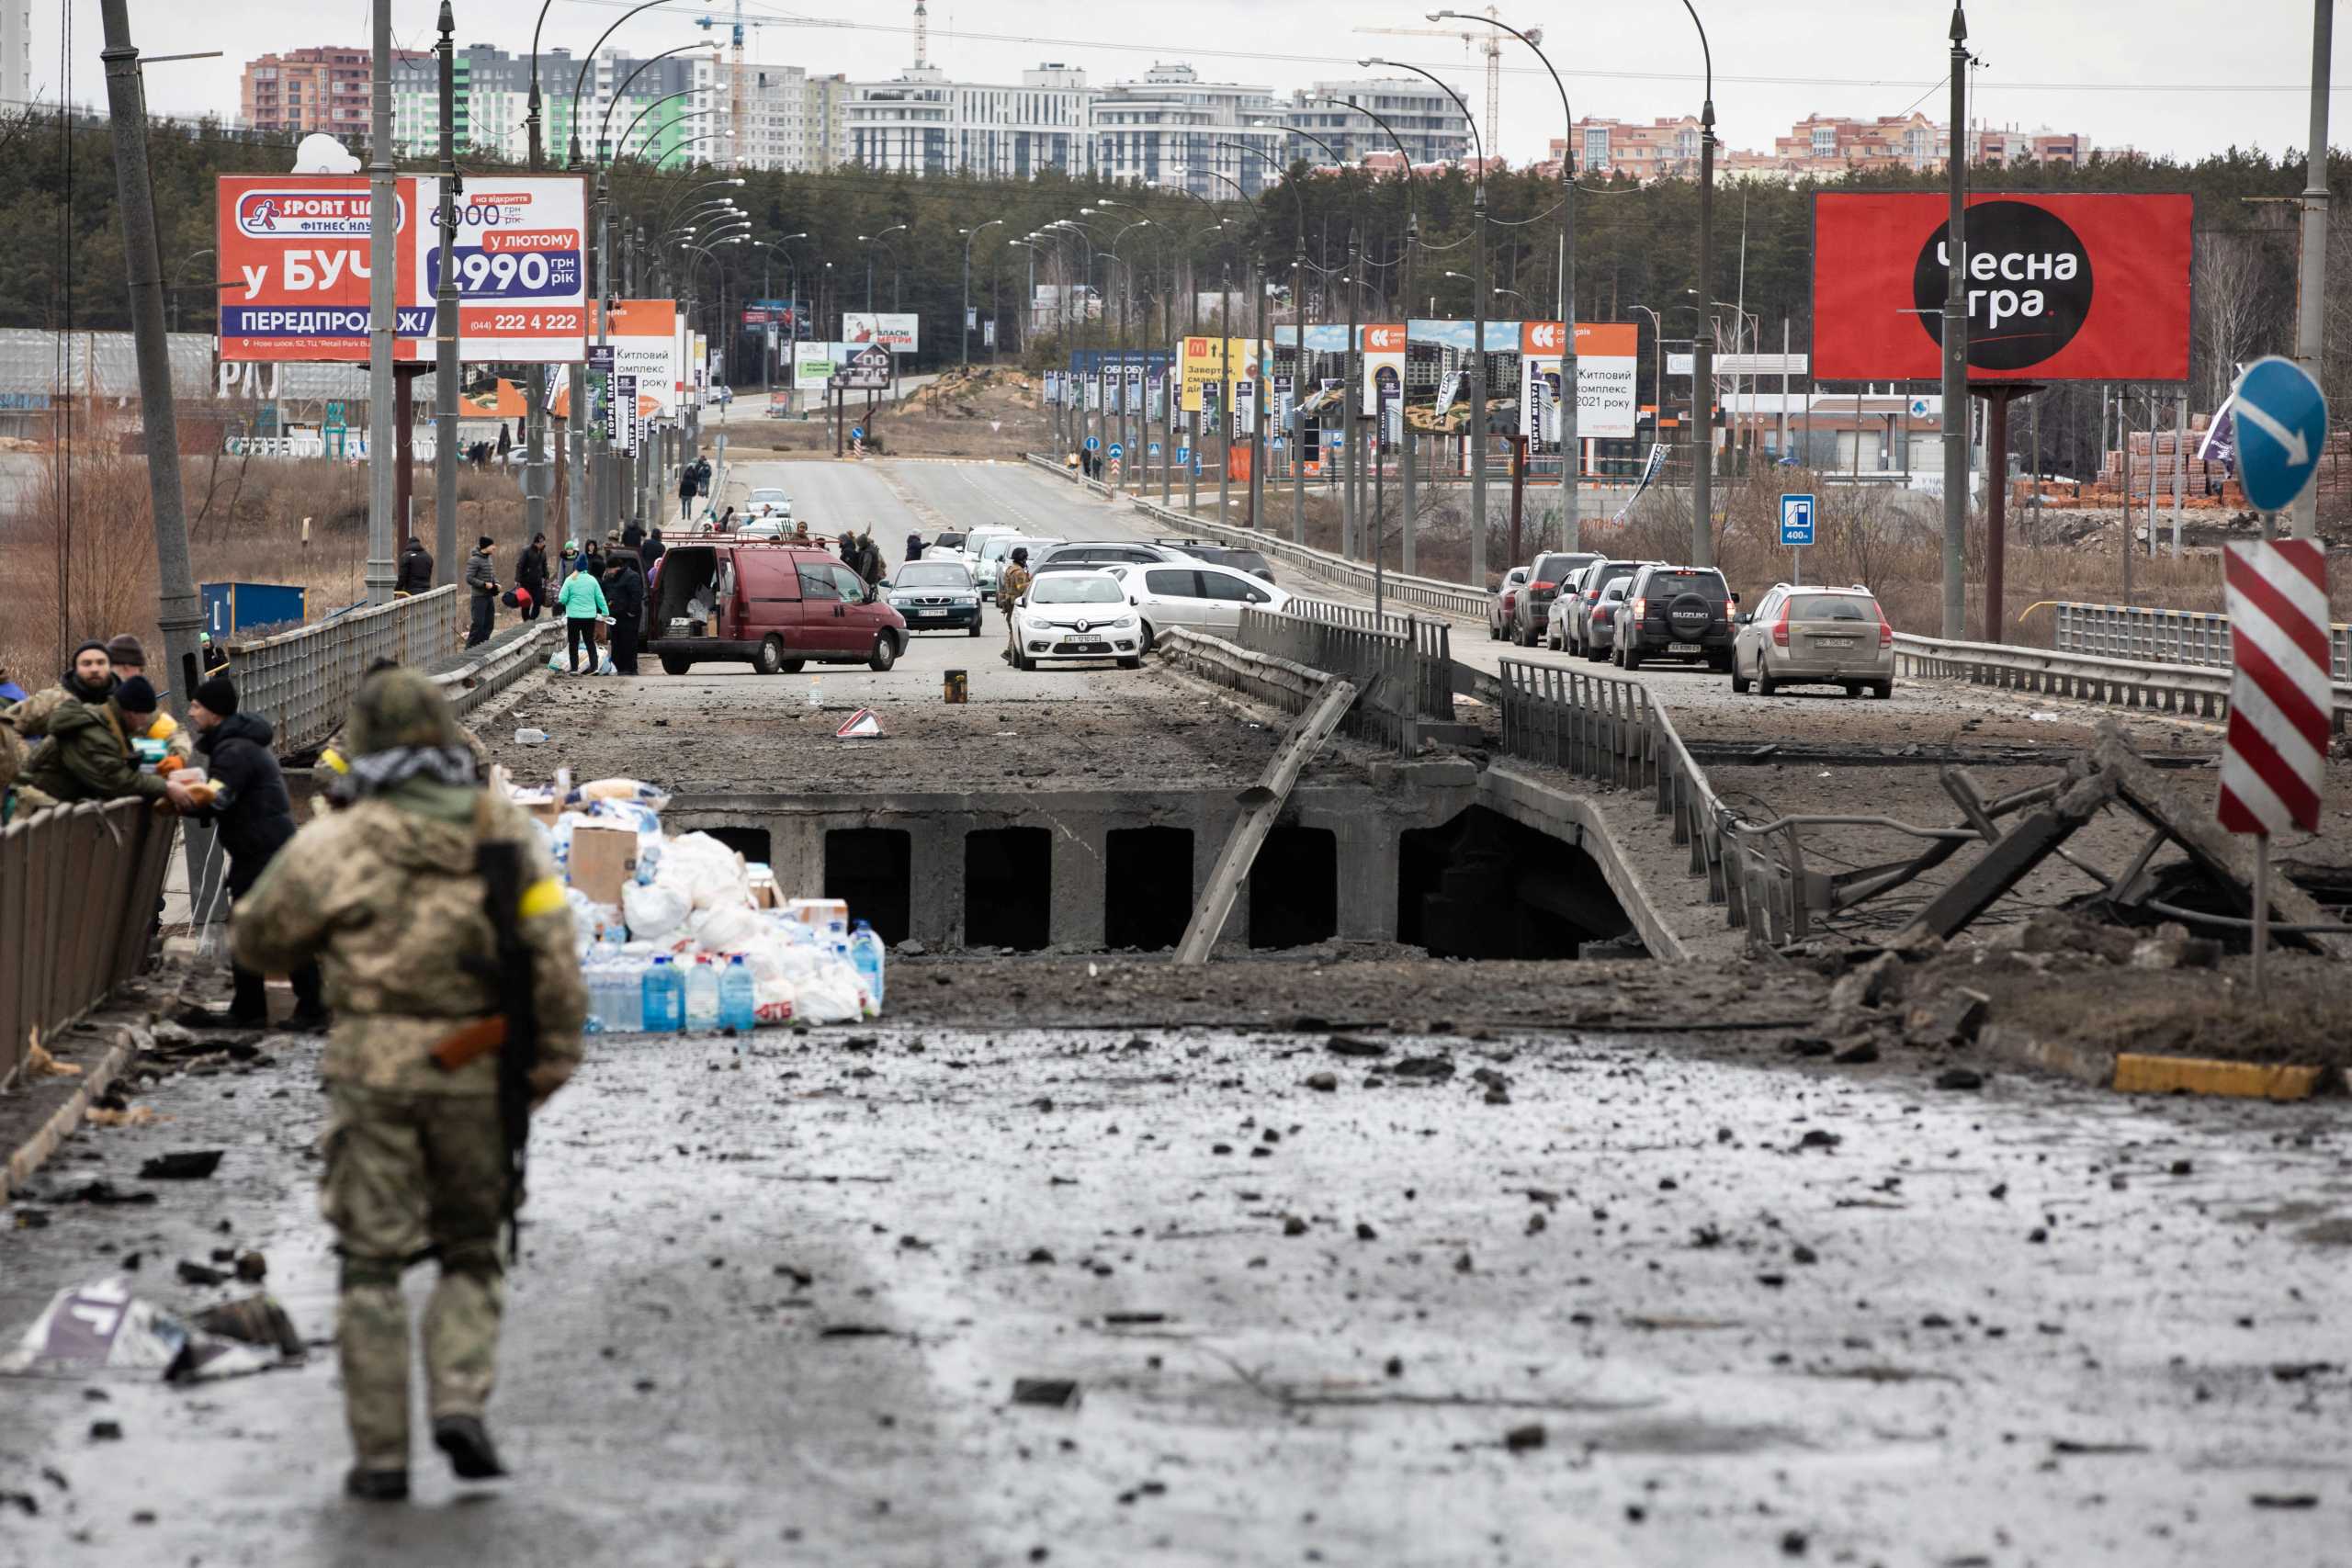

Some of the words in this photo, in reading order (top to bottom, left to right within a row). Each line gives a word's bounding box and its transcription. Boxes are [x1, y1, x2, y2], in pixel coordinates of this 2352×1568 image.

[283, 200, 345, 215] SPORT
[351, 200, 372, 215] LI
[504, 206, 521, 215] грн
[300, 221, 345, 231] ФІТНЕС
[491, 236, 501, 251] у
[505, 233, 573, 249] лютому
[551, 257, 574, 271] грн
[551, 272, 574, 287] рік
[242, 311, 427, 333] ПЕРЕДПРОЖ!
[470, 320, 492, 332] (044)
[494, 314, 526, 331] 222
[530, 314, 541, 330] 4
[546, 314, 577, 330] 222
[618, 364, 664, 374] омплекс
[642, 377, 669, 389] року
[1604, 399, 1630, 410] року
